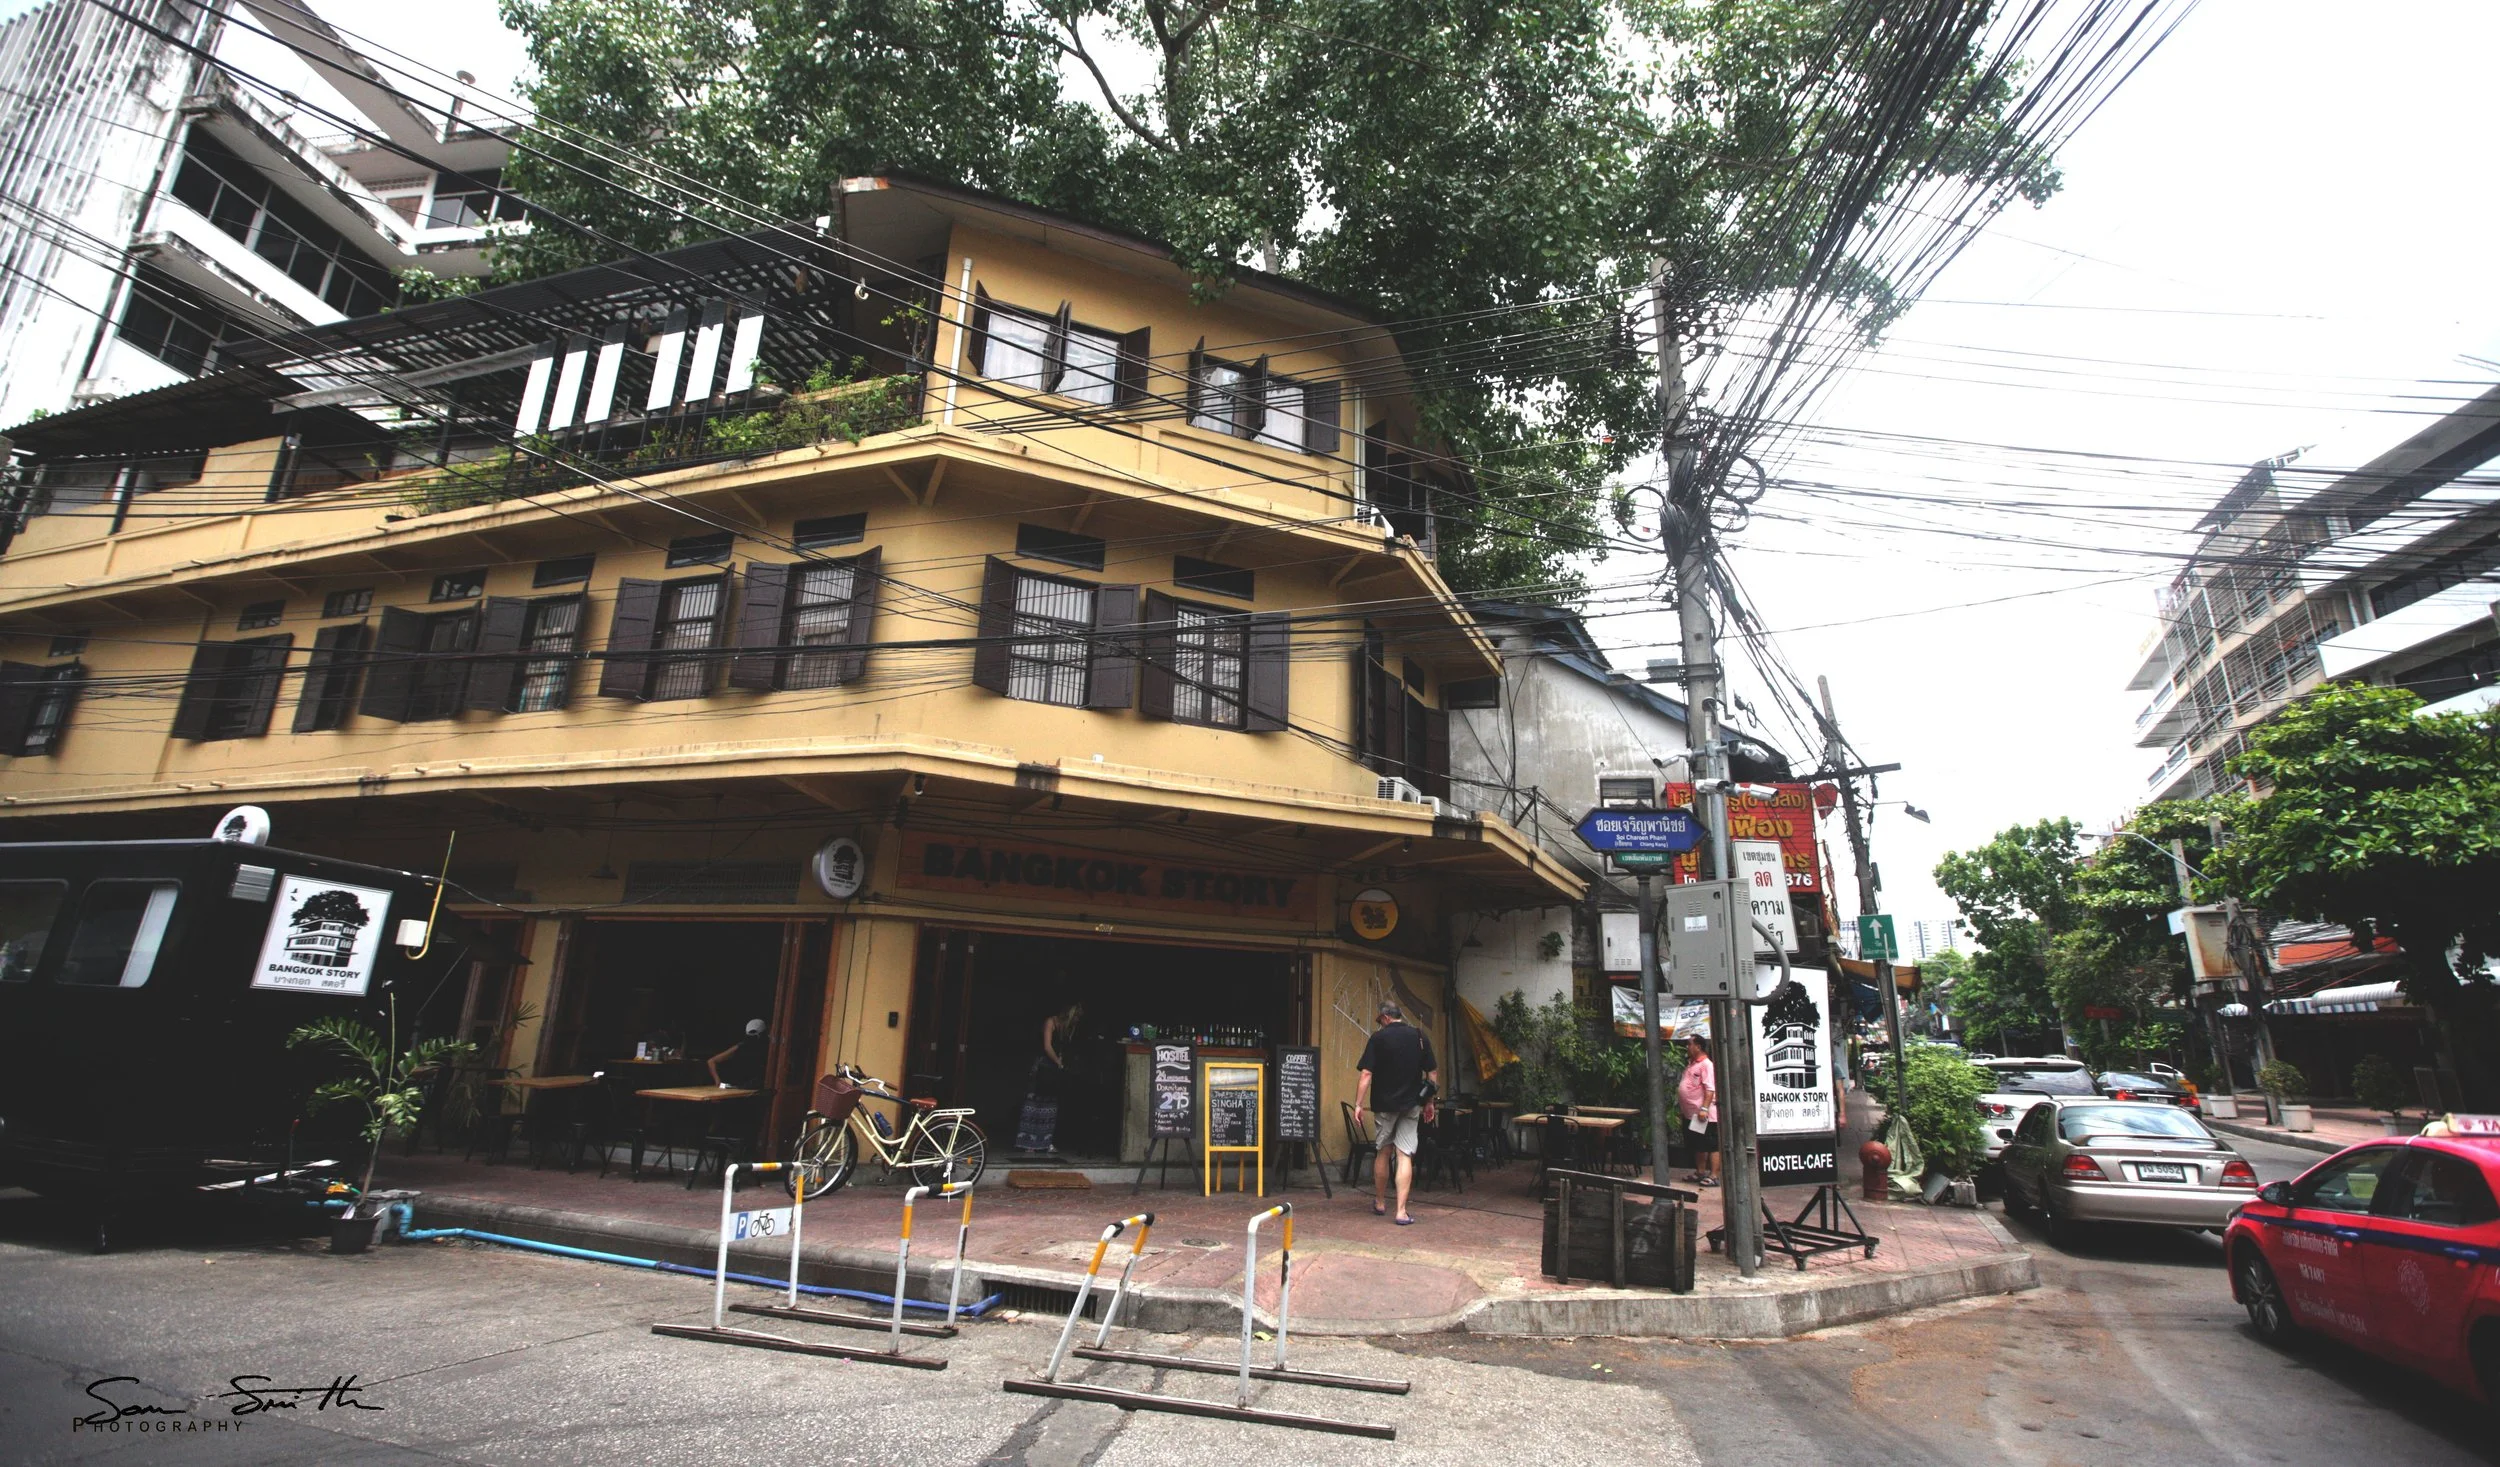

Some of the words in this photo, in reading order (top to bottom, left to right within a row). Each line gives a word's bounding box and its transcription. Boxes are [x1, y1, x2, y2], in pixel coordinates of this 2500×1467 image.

[922, 842, 1149, 897] BANGKOK
[1160, 868, 1298, 908] STORY
[1754, 871, 1773, 887] ลด
[1750, 900, 1785, 916] ความ
[268, 964, 324, 976] BANGKOK
[326, 969, 361, 979] STORY
[1156, 1050, 1191, 1062] HOSTEL
[1160, 1092, 1190, 1110] 295
[1211, 1099, 1244, 1108] SINGHA
[1759, 1092, 1801, 1103] BANGKOK
[1803, 1092, 1828, 1102] STORY
